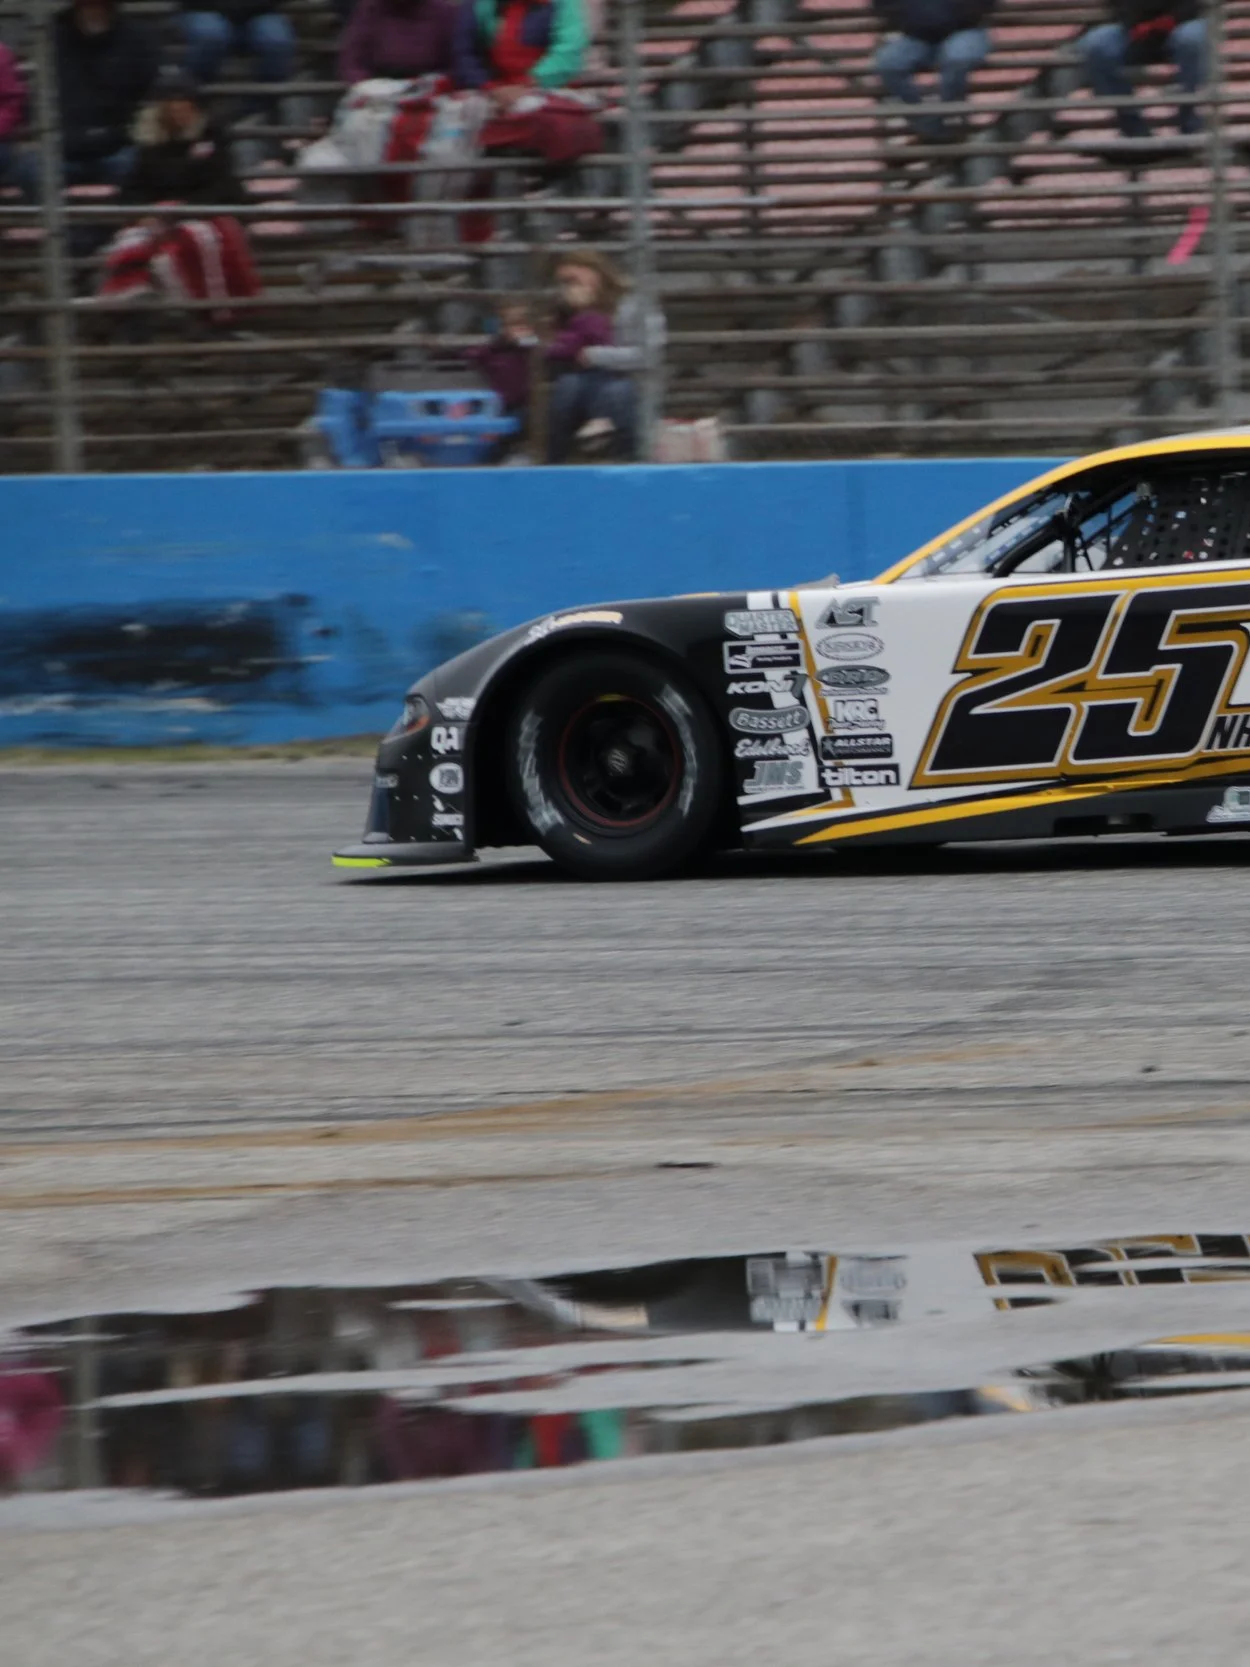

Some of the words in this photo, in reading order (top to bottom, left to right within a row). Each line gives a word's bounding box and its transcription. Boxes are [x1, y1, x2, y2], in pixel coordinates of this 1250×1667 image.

[736, 709, 801, 730] Bassett
[833, 698, 879, 722] KRC
[834, 736, 892, 747] ALLSTAR
[821, 767, 897, 786] tilton
